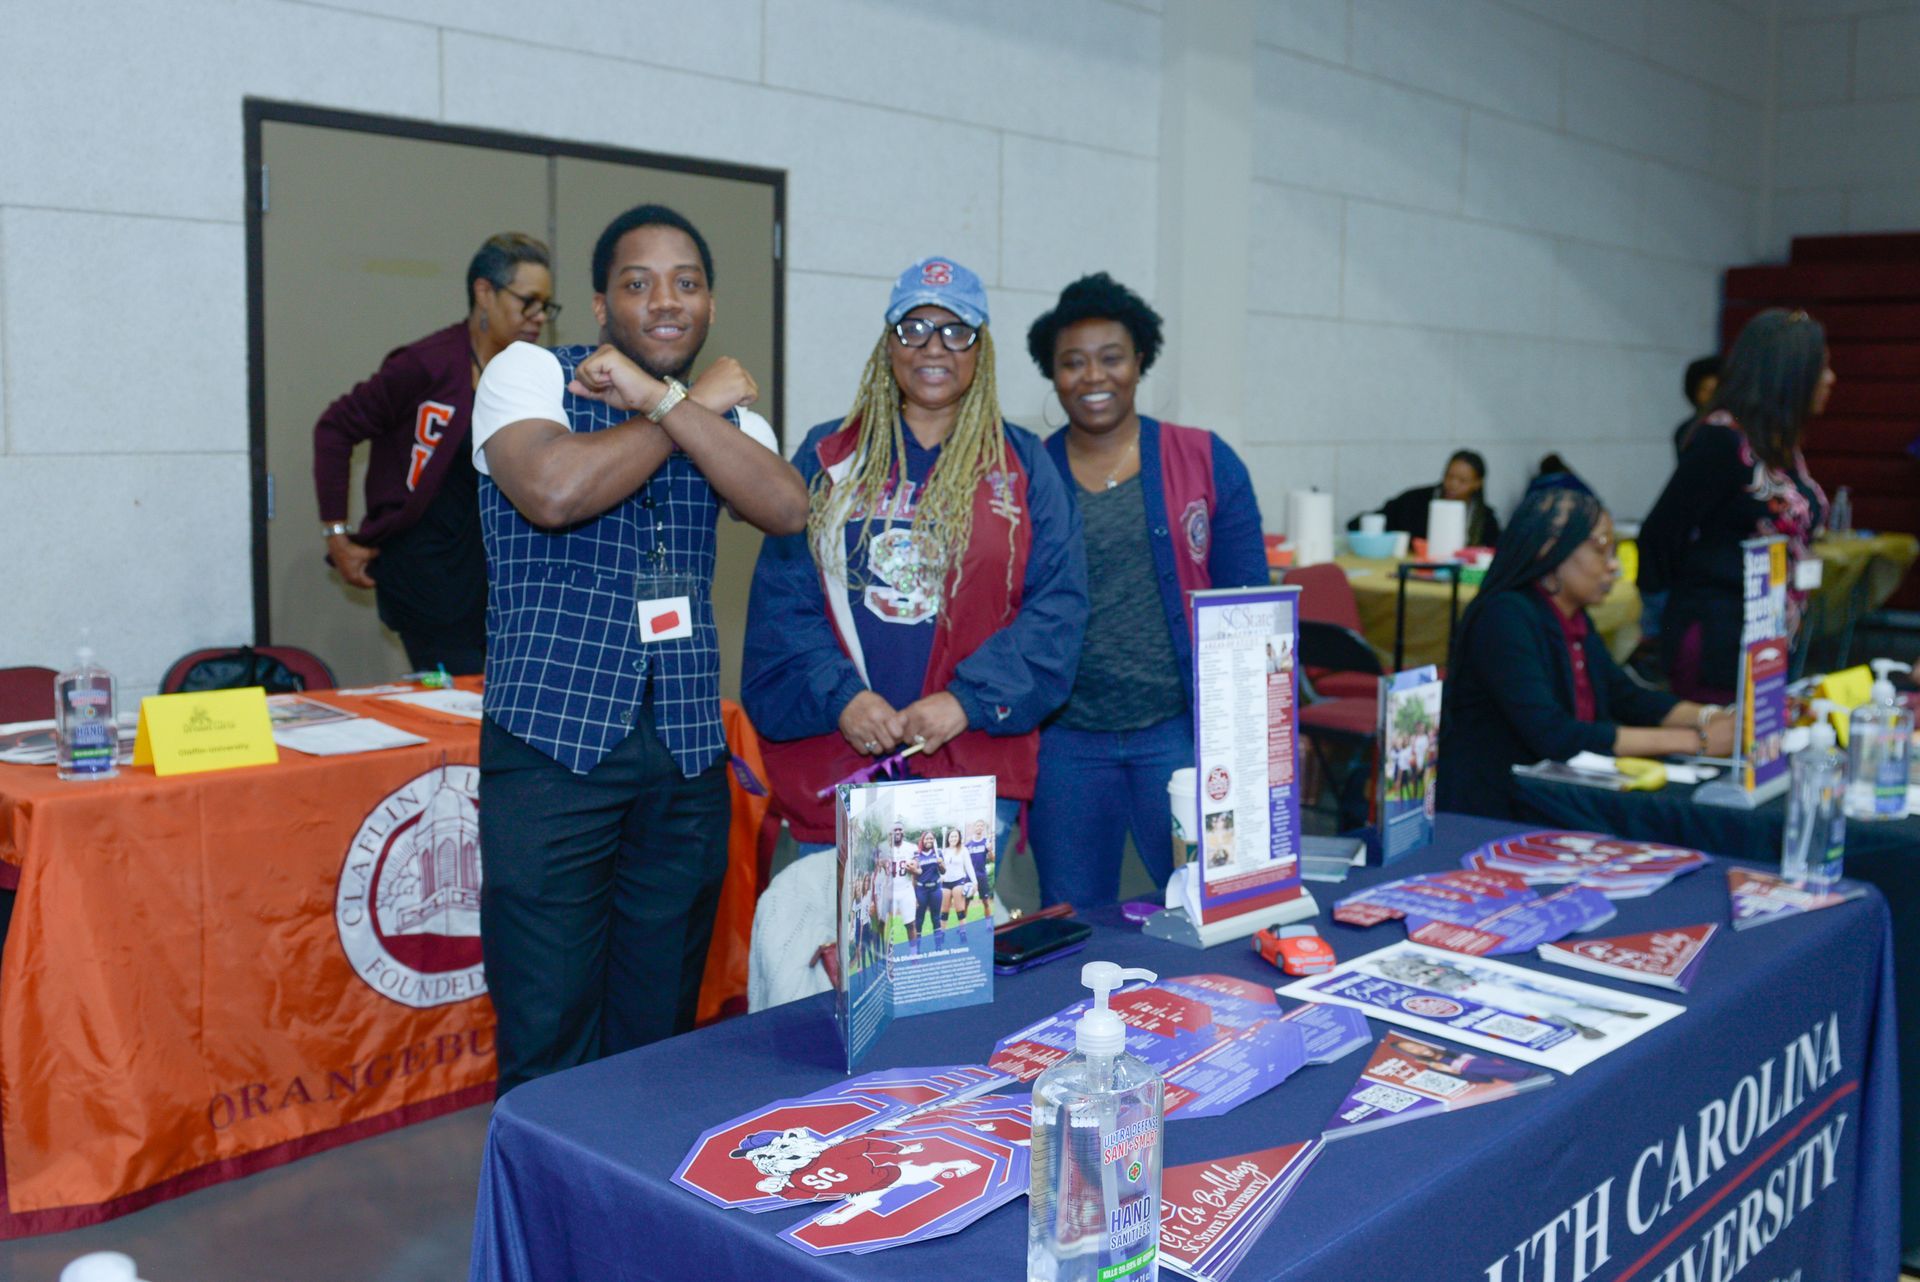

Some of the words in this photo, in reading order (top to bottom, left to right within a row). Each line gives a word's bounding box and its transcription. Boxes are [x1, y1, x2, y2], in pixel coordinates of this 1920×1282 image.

[341, 787, 422, 928] CLAFLIN
[364, 956, 487, 1001] FOUNDED
[1103, 1126, 1131, 1149] ULTRA
[1626, 1010, 1843, 1236] CAROLINA
[801, 1167, 849, 1191] SC
[1192, 1160, 1272, 1208] Bulldogs
[1109, 1194, 1151, 1236] HAND
[1193, 1219, 1228, 1244] STATE
[1214, 1176, 1268, 1221] UNIVERSITY
[1109, 1220, 1151, 1250] SANITIZER
